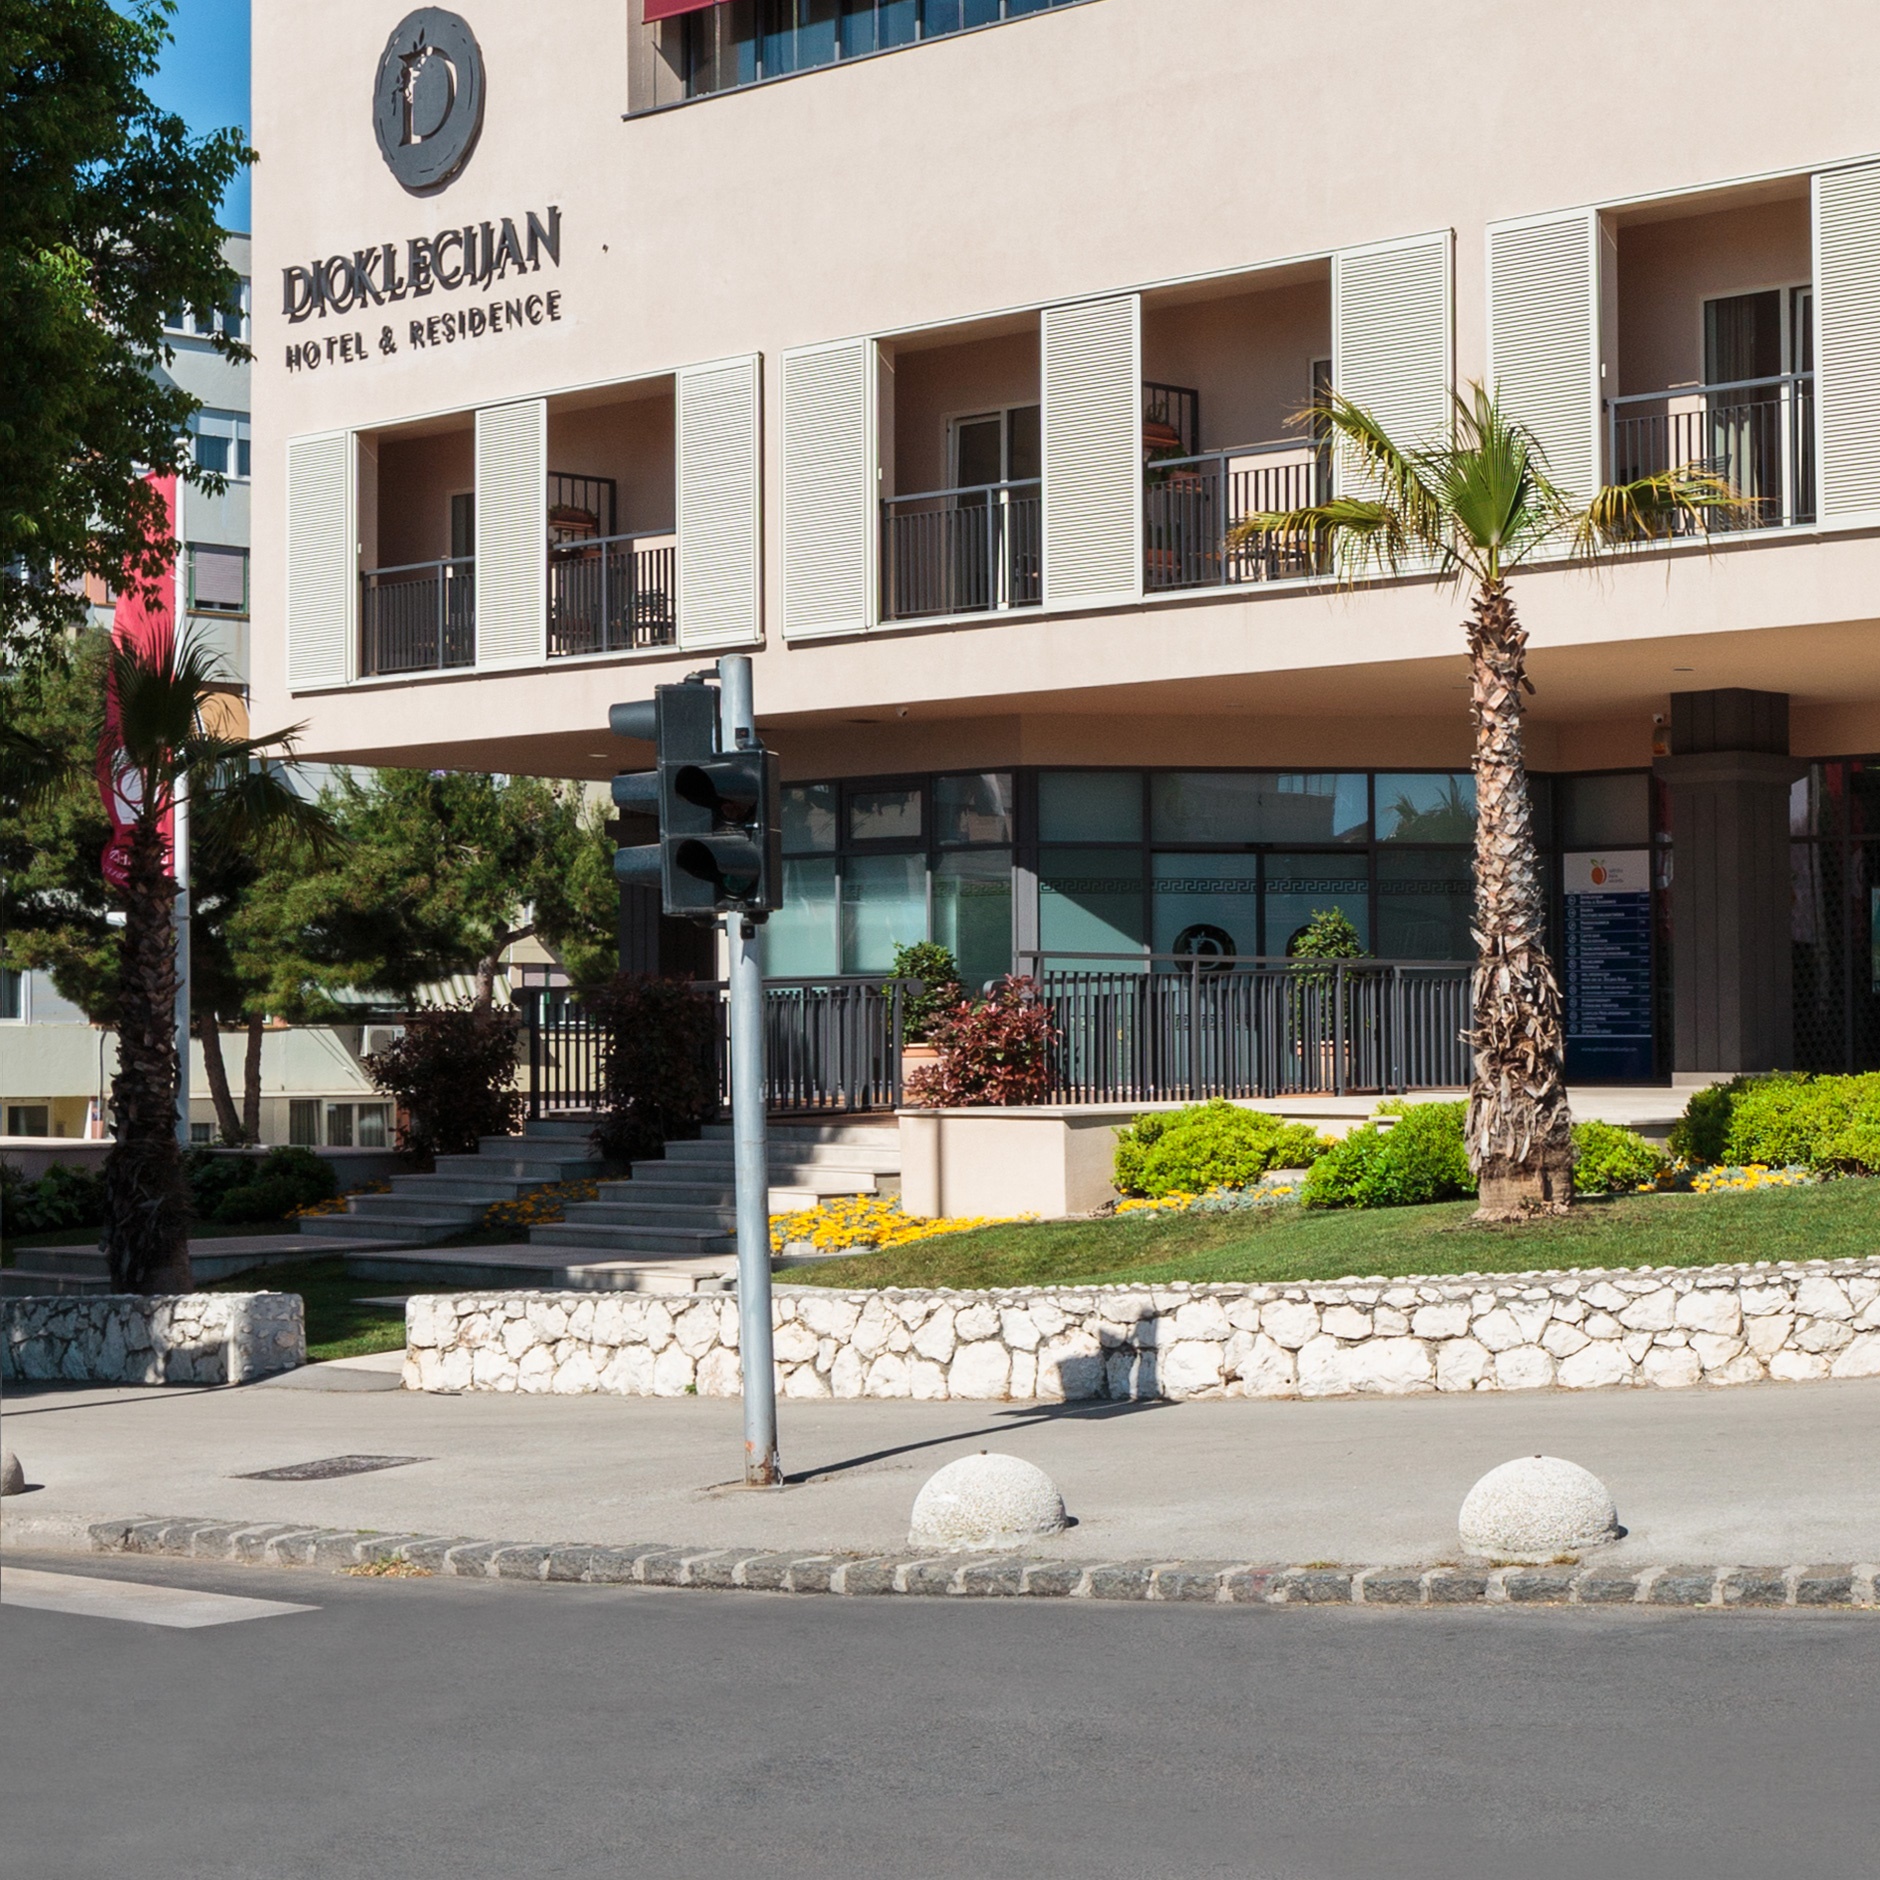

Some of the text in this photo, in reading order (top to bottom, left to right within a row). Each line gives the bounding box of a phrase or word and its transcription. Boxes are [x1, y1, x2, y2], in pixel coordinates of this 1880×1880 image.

[281, 206, 562, 321] DIOKLECIJAN
[286, 291, 562, 372] HOTEL & RESIDENCE
